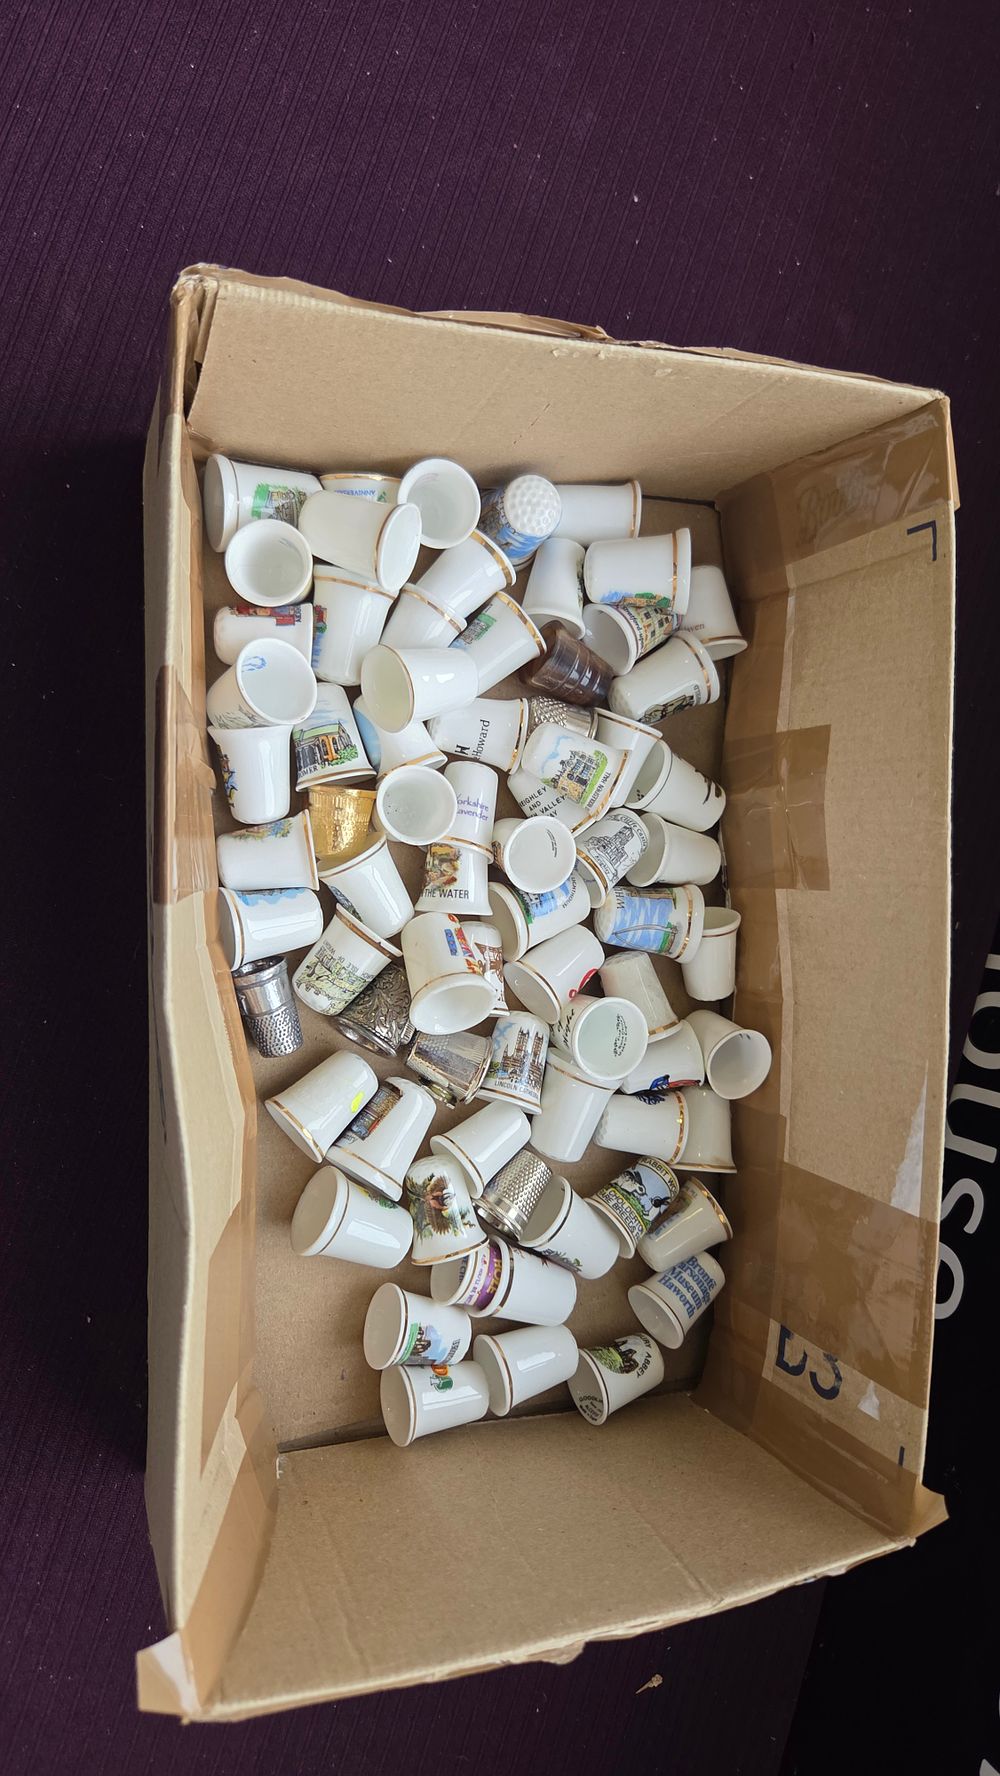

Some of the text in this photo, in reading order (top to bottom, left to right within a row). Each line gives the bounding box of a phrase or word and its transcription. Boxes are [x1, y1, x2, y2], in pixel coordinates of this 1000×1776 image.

[474, 719, 490, 758] Howard
[457, 807, 489, 821] avender
[528, 800, 542, 812] AND
[424, 889, 469, 899] THE WATER
[608, 1190, 644, 1232] CHOLDERTO
[612, 1201, 637, 1233] BREEDS
[658, 1275, 695, 1318] Haworth
[668, 1268, 702, 1308] Museum
[635, 1351, 652, 1378] ABBEY
